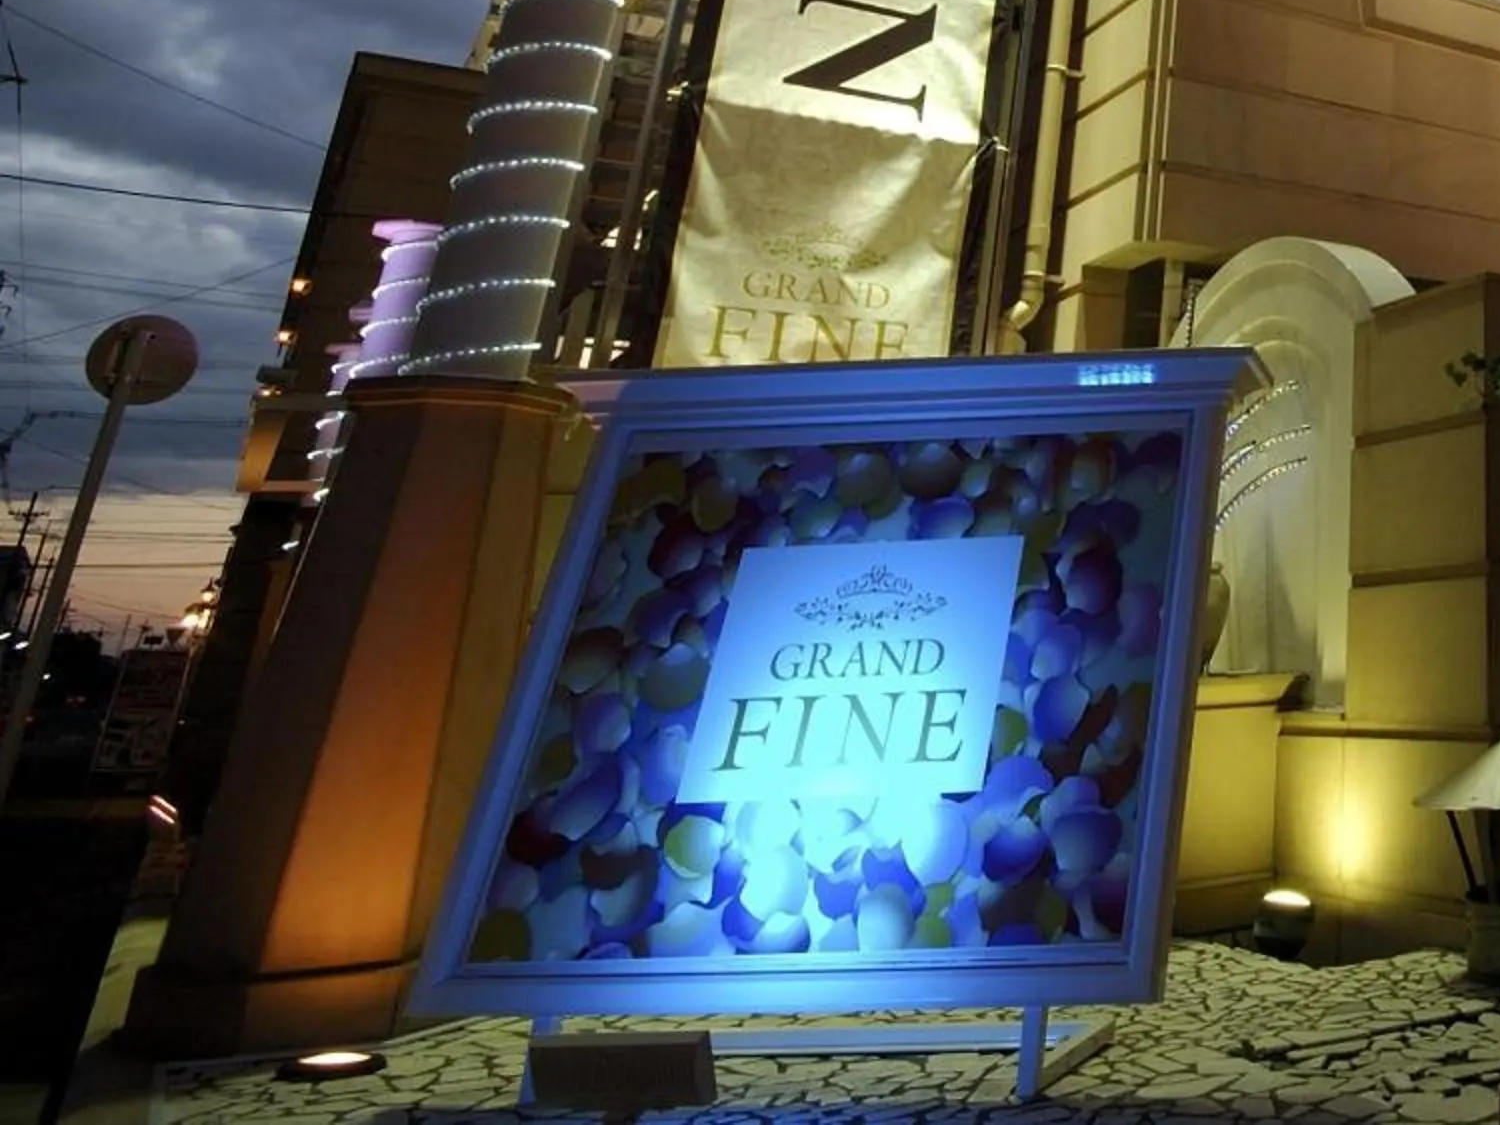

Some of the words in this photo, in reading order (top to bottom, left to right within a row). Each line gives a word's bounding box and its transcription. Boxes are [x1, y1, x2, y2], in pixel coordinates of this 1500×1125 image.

[742, 271, 891, 310] GRAND
[705, 305, 909, 362] FINE
[768, 637, 946, 682] GRAND
[711, 688, 968, 772] FINE
